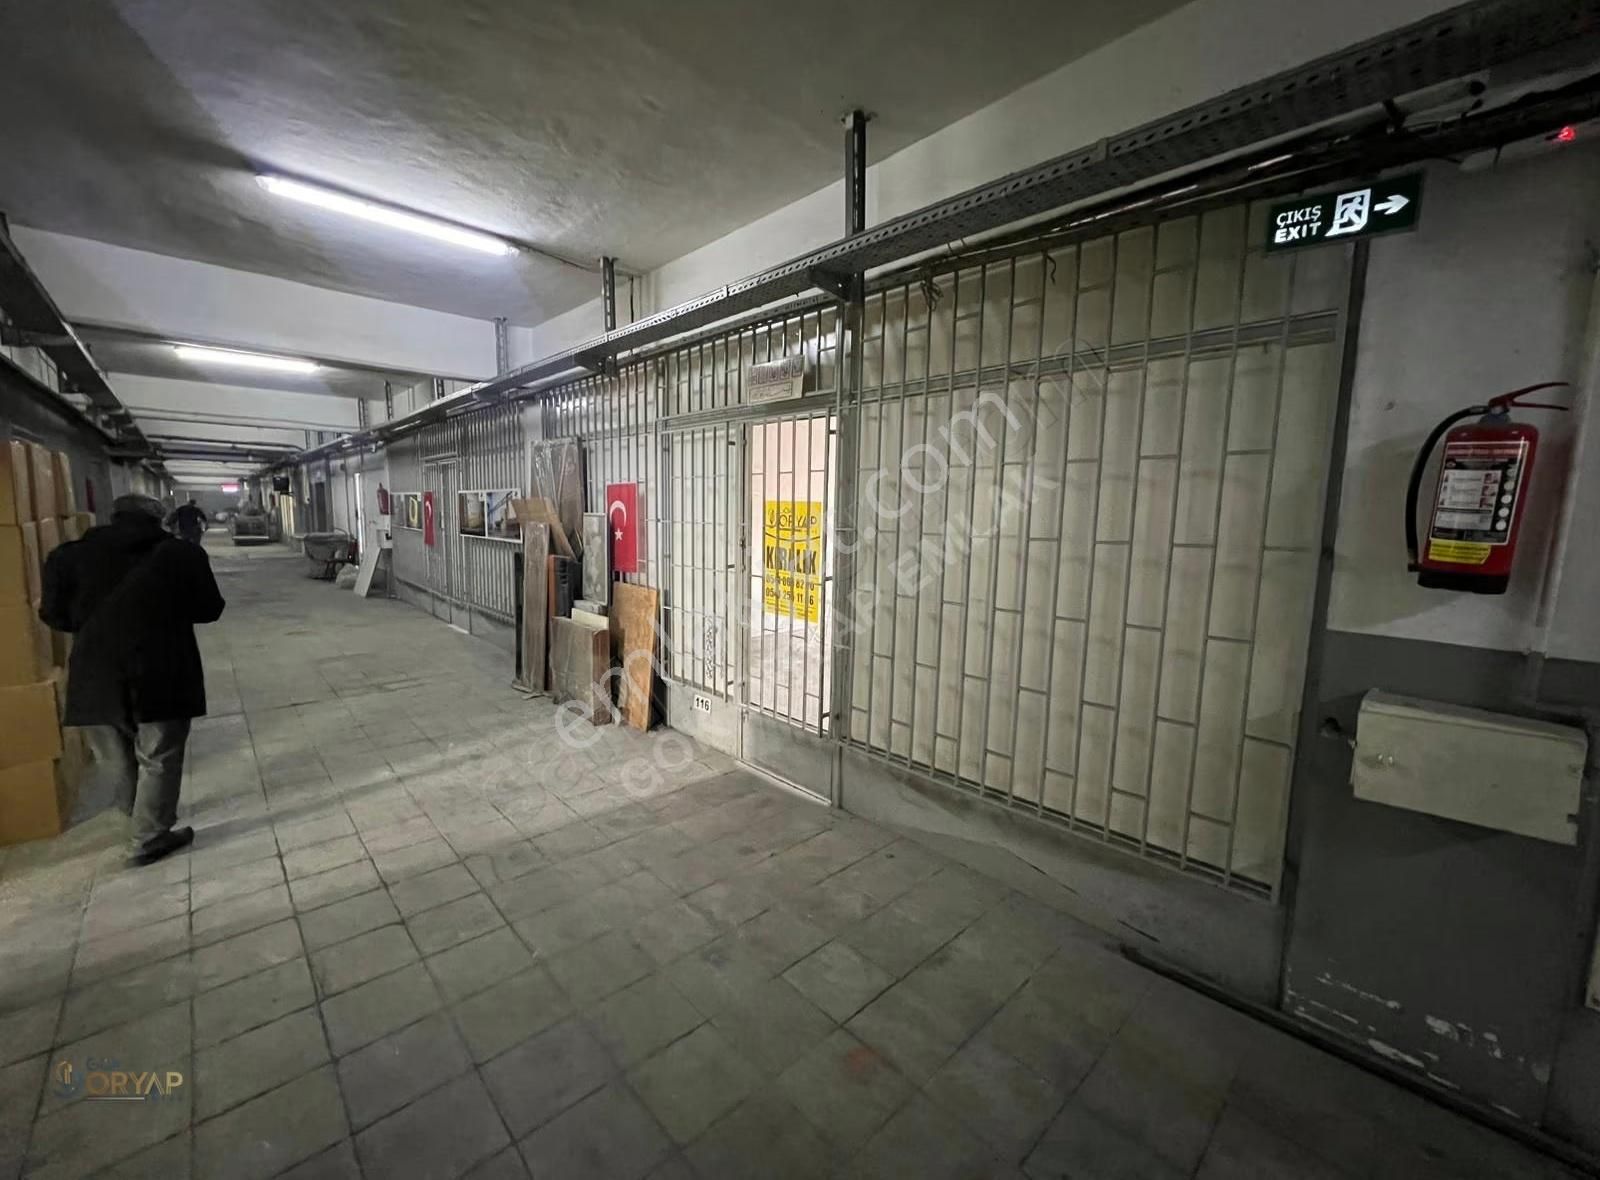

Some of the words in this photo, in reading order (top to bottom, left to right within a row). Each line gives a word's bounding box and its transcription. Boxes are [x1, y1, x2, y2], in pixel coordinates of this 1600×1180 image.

[1276, 204, 1323, 228] ÇIKIŞ
[1274, 222, 1322, 243] EXIT
[695, 697, 710, 711] 116
